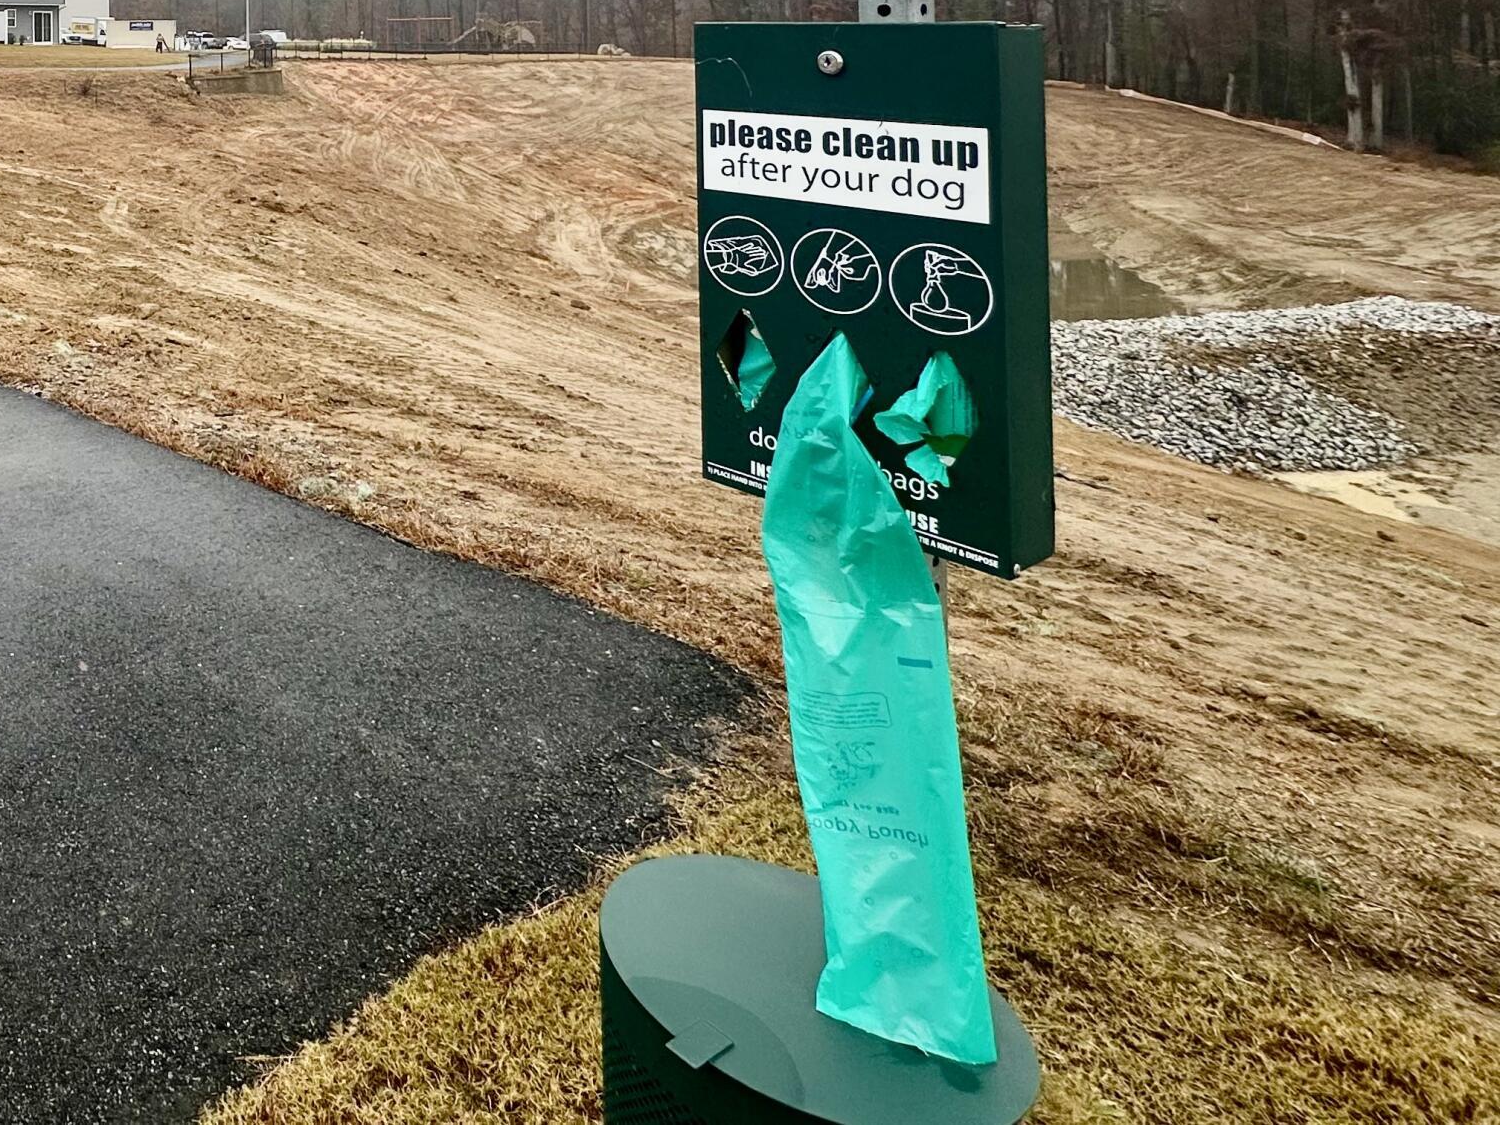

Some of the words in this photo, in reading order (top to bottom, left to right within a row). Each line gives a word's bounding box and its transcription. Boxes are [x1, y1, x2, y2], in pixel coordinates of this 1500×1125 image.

[709, 119, 812, 154] please
[822, 127, 920, 164] clean
[932, 138, 979, 171] up
[720, 153, 792, 183] after
[802, 164, 879, 193] your
[891, 169, 964, 210] dog
[749, 426, 778, 451] do
[930, 539, 937, 548] A
[937, 542, 958, 555] KNOT
[965, 551, 999, 569] DISPOSE
